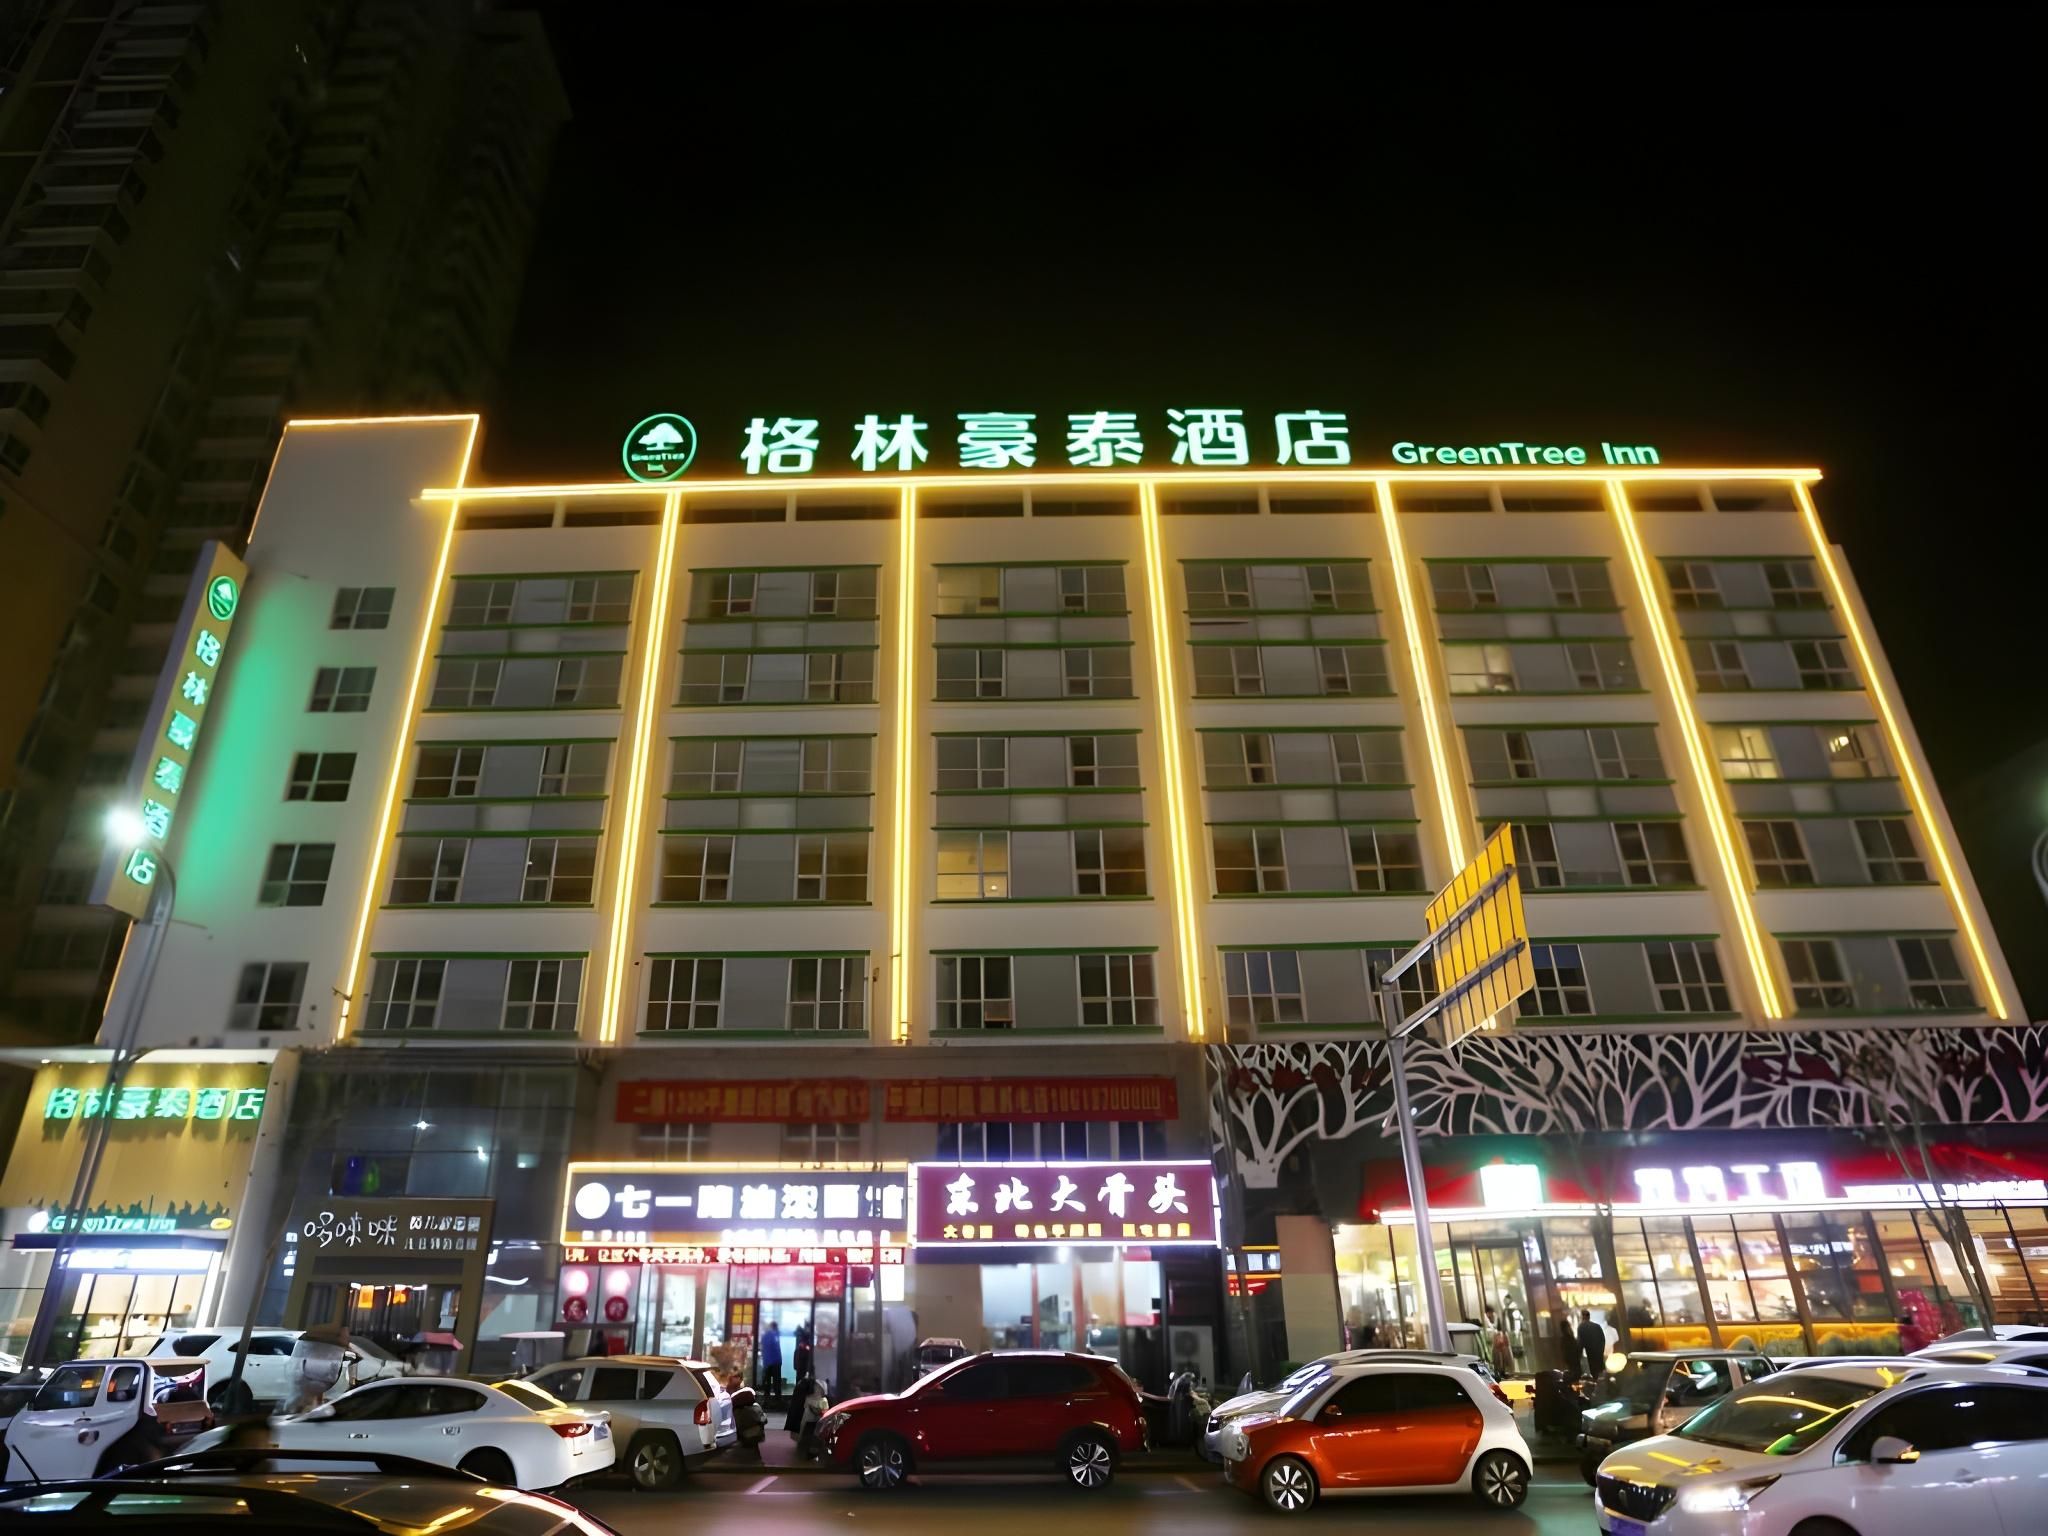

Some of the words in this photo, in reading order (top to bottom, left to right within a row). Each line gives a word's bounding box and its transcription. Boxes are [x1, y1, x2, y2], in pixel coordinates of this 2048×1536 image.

[741, 408, 1351, 474] 格林豪泰酒店
[1391, 442, 1586, 464] GreenTree
[1601, 442, 1660, 464] Inn
[945, 1172, 1189, 1218] 东北大骨头
